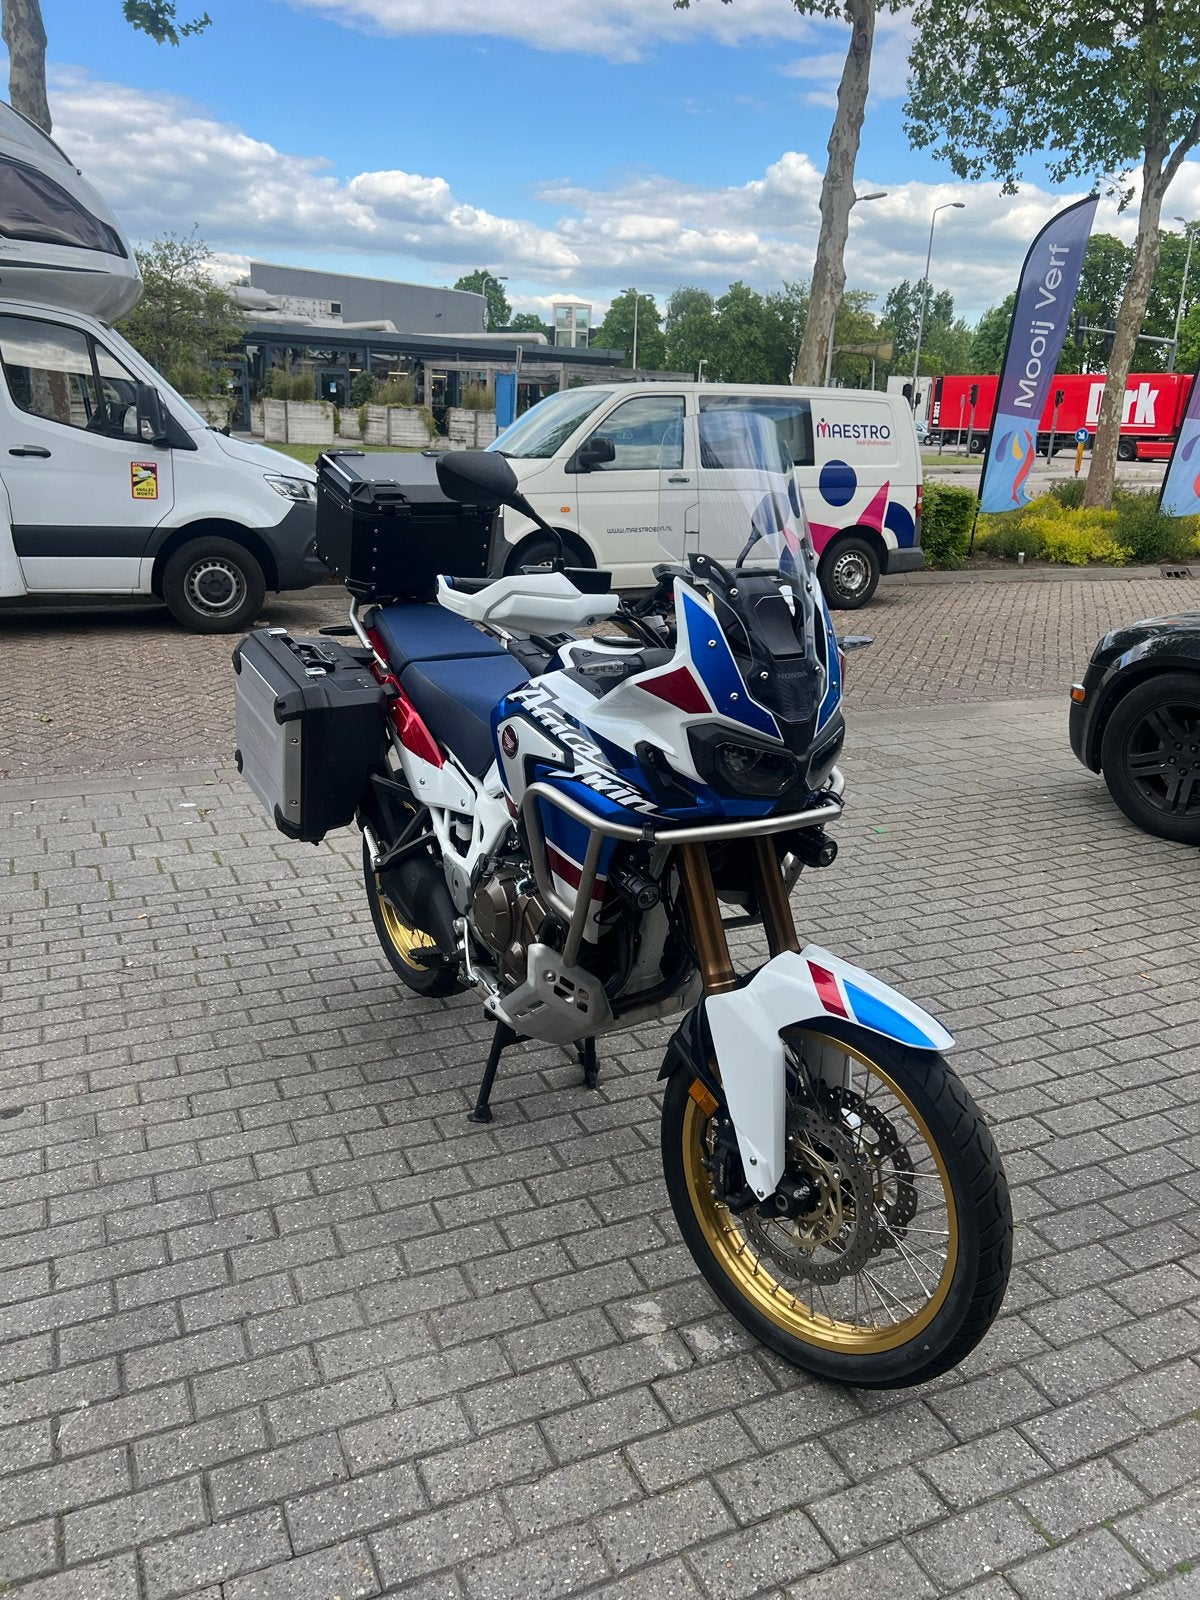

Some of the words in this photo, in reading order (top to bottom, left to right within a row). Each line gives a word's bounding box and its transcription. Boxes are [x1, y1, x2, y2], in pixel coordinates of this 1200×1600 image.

[1013, 320, 1055, 408] Mooij
[1034, 243, 1070, 310] Verf
[816, 417, 891, 439] MAESTRO
[1085, 382, 1160, 424] Drk
[776, 670, 809, 680] HONDA
[506, 685, 605, 762] Africa
[547, 751, 662, 815] Twin
